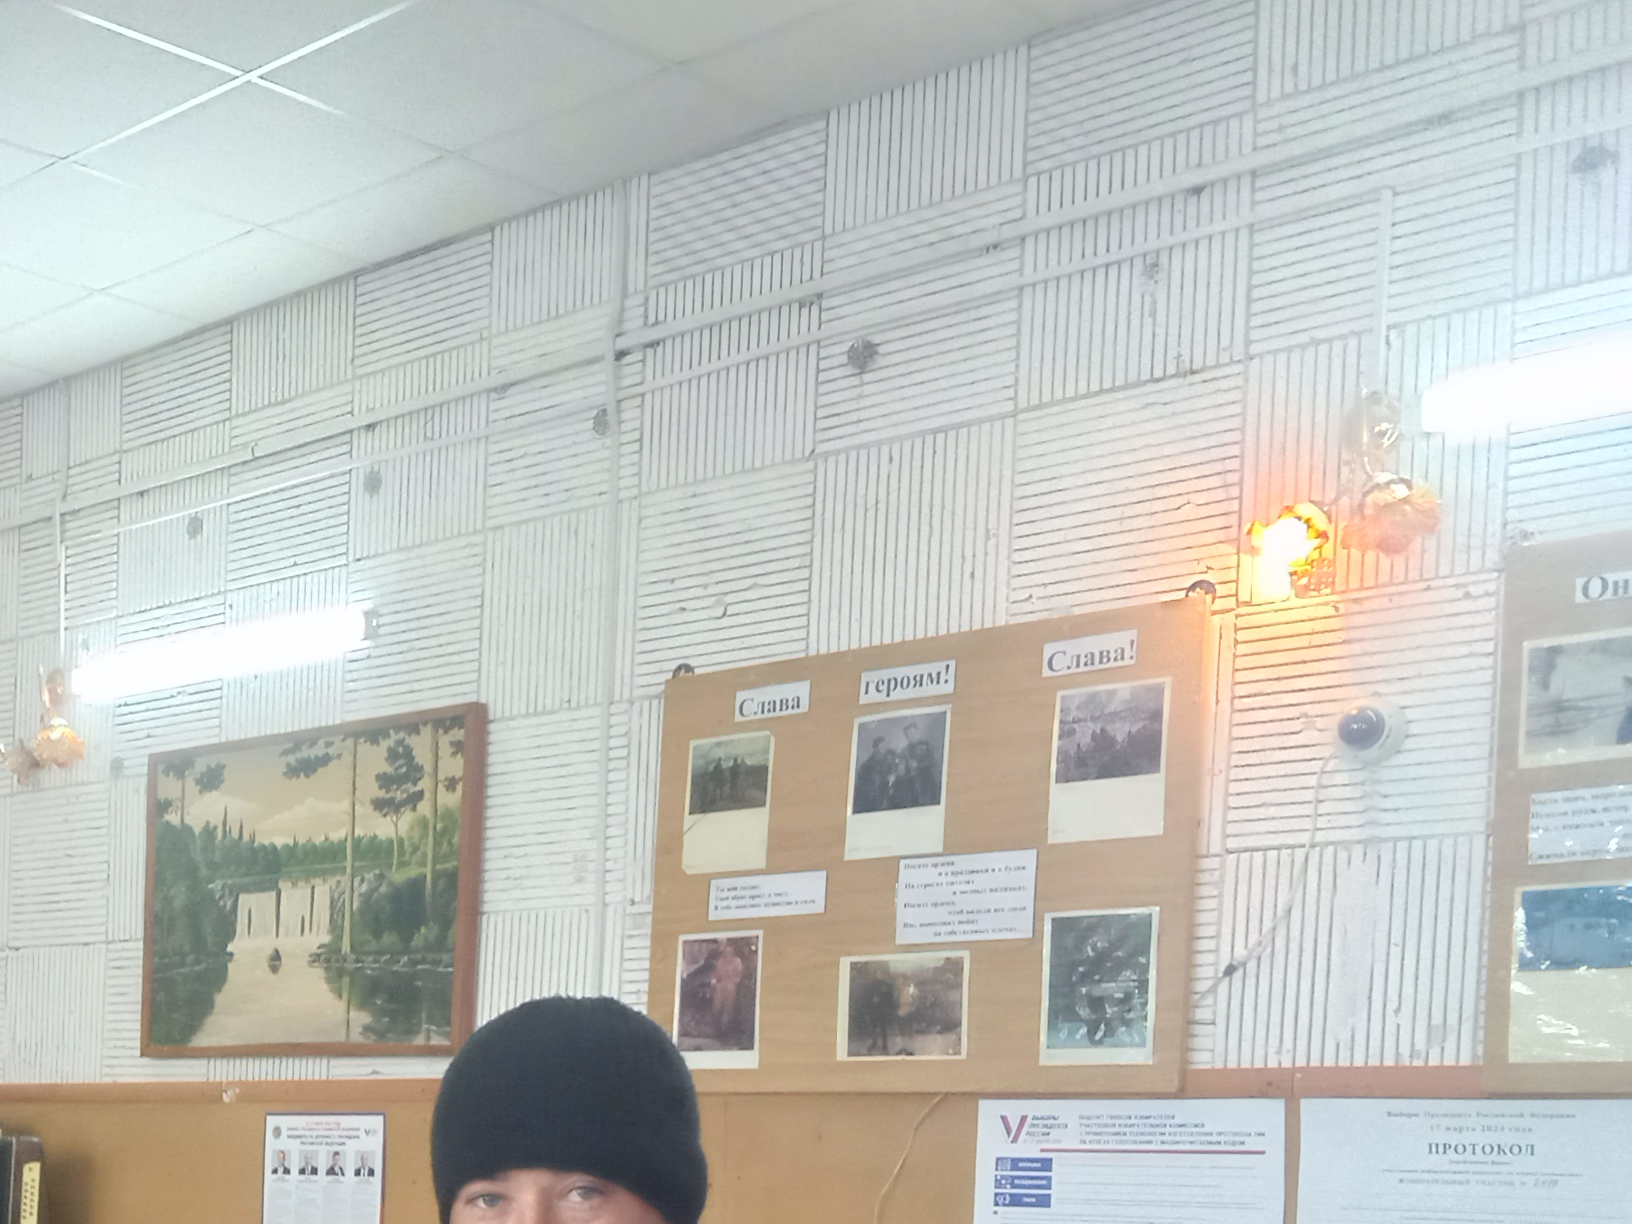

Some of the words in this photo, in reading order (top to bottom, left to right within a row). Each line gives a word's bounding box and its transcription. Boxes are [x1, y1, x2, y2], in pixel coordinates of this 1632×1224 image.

[1047, 639, 1135, 672] Слава!
[864, 664, 950, 697] героям!
[738, 694, 801, 718] Слава
[1428, 1142, 1536, 1156] ПРОТОКОЛ
